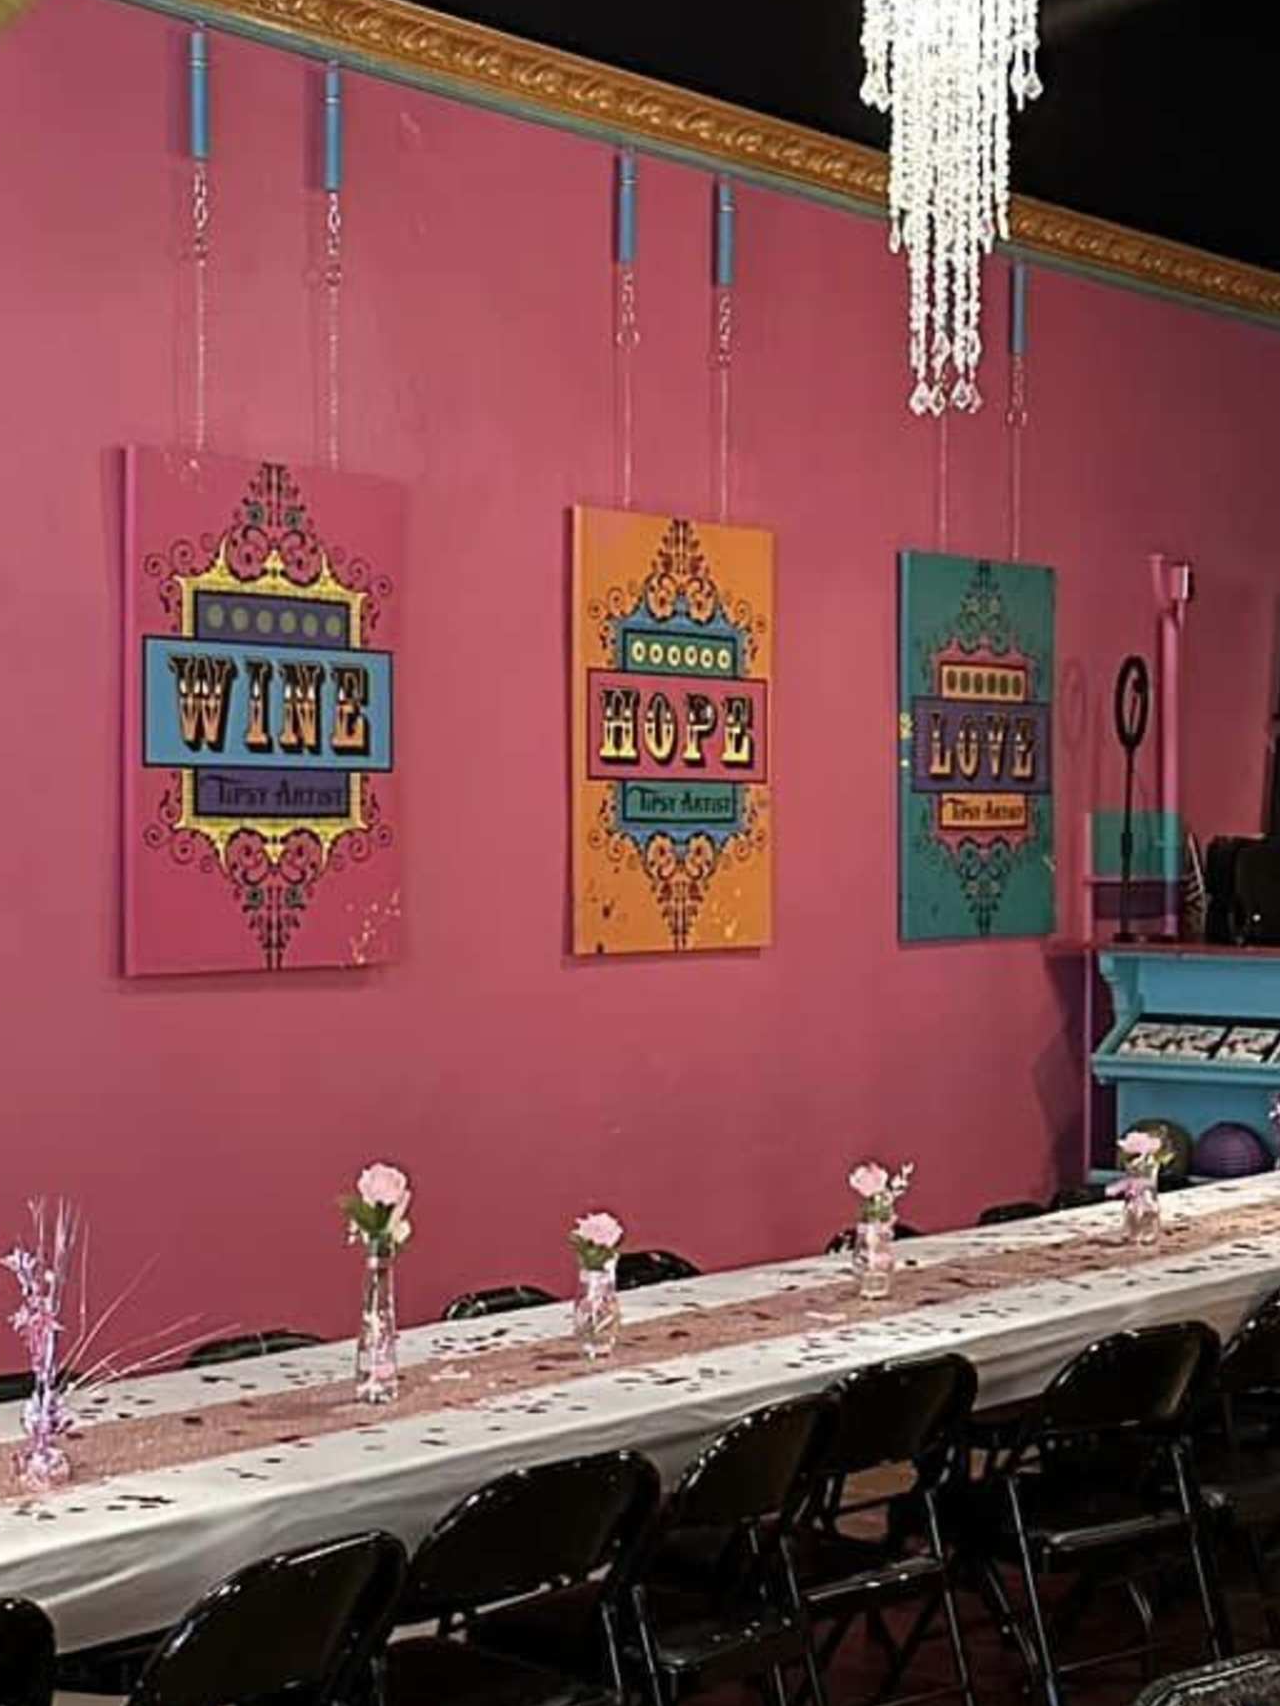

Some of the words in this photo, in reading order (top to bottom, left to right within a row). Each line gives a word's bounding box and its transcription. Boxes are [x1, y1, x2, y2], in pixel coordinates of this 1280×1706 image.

[168, 652, 371, 756] WINE
[599, 686, 754, 768] HOPE
[928, 712, 1035, 782] LOVE
